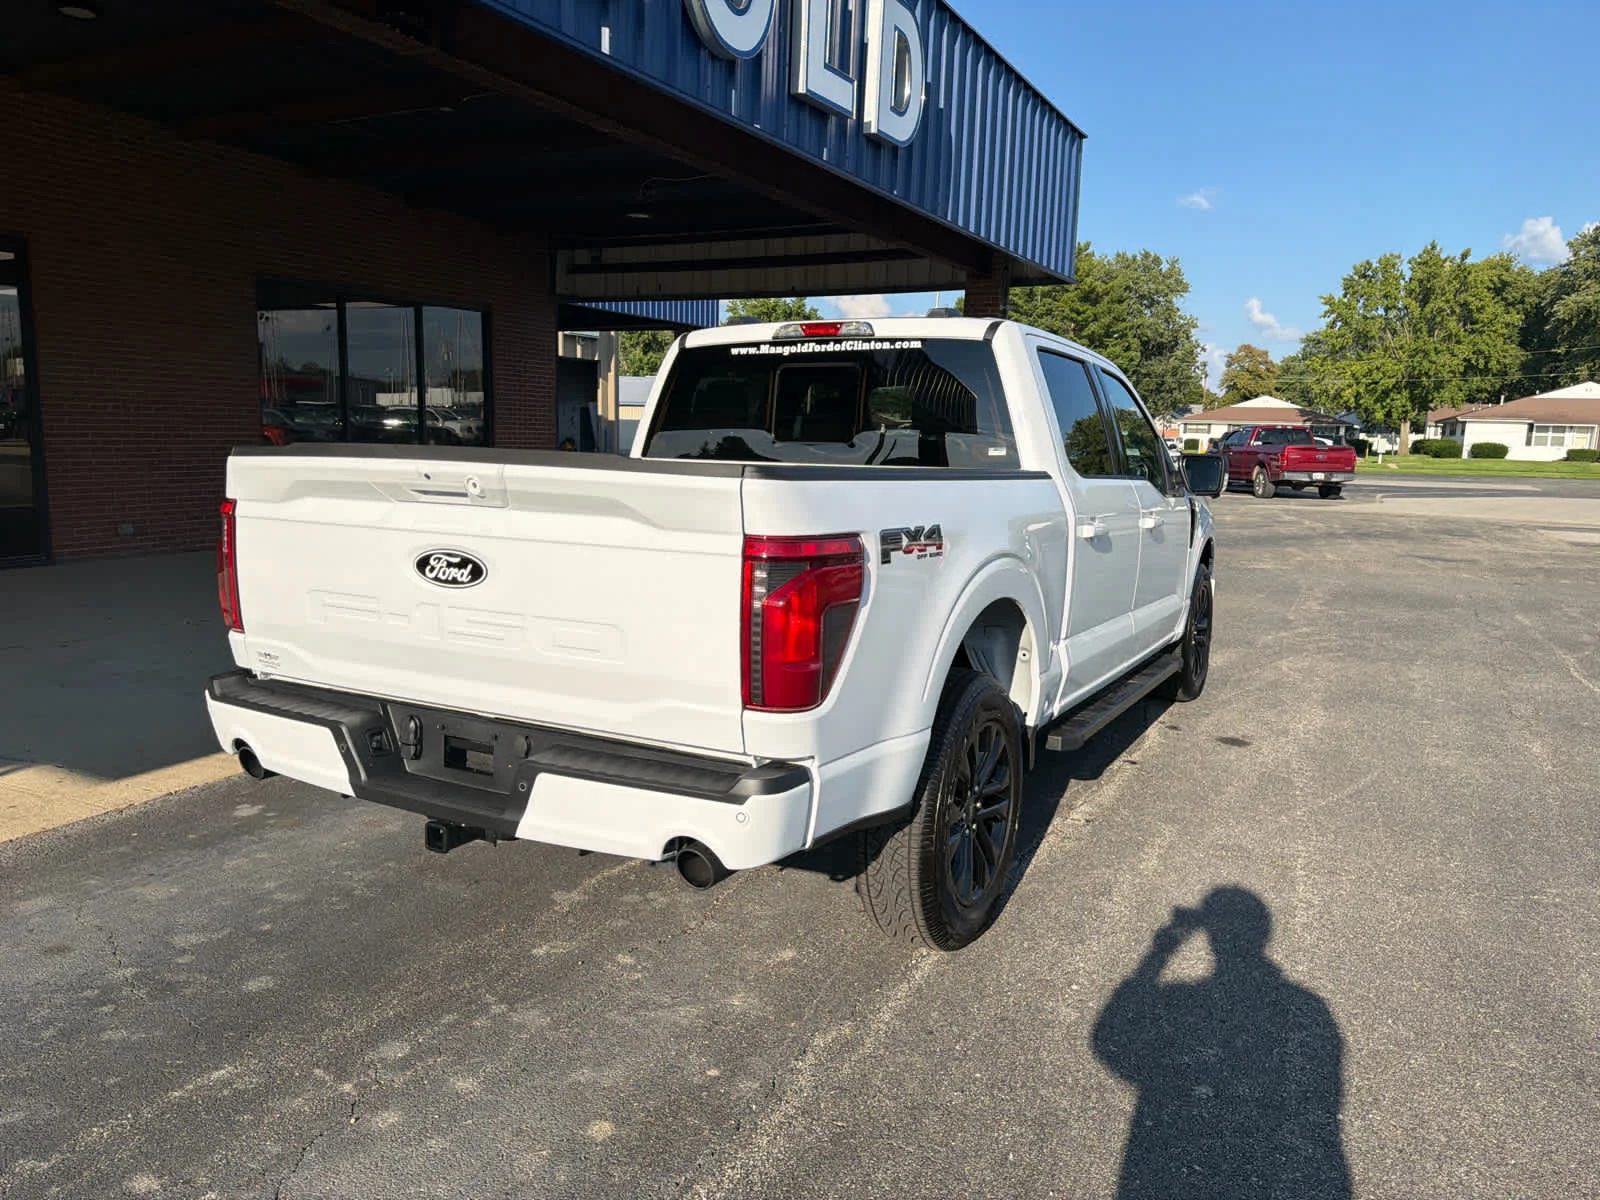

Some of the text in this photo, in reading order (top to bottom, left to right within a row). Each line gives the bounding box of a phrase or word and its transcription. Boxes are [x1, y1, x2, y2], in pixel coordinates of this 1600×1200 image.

[730, 340, 922, 356] www.MangoldFordofClinton.com
[880, 524, 943, 564] FX4
[425, 554, 473, 582] Ford
